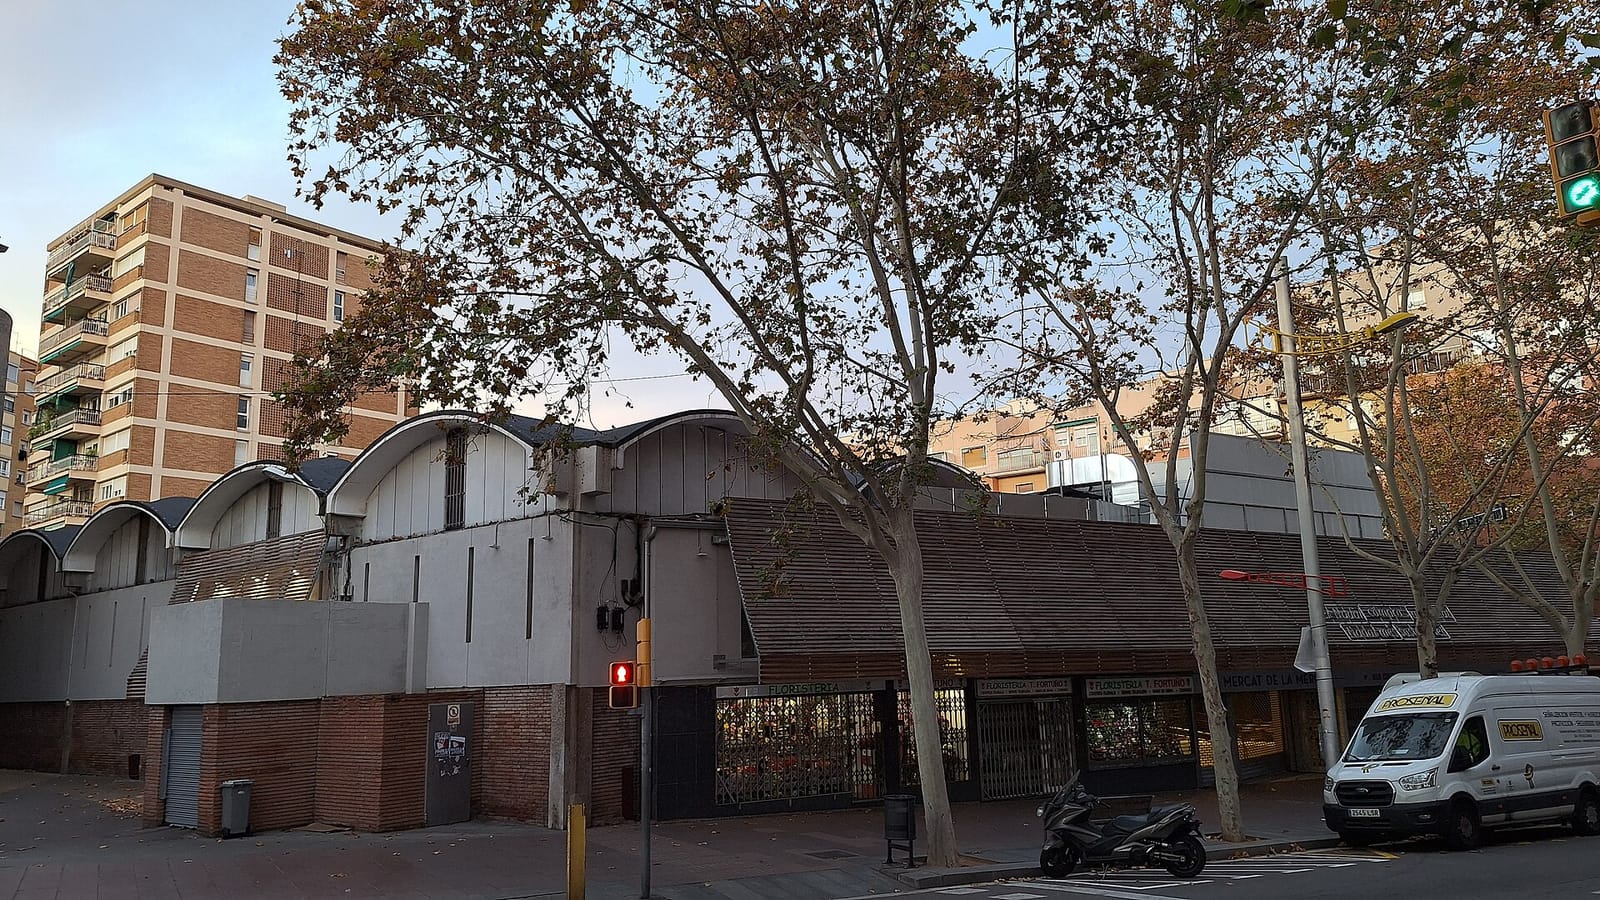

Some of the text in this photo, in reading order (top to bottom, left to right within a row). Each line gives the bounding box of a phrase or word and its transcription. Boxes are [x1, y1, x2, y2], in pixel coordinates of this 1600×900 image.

[985, 681, 1026, 690] FLORISTERIA
[1095, 679, 1143, 690] FLORISTERIA
[1223, 673, 1317, 688] MERCAT DE LA MER
[768, 683, 839, 695] FLORISTERIA
